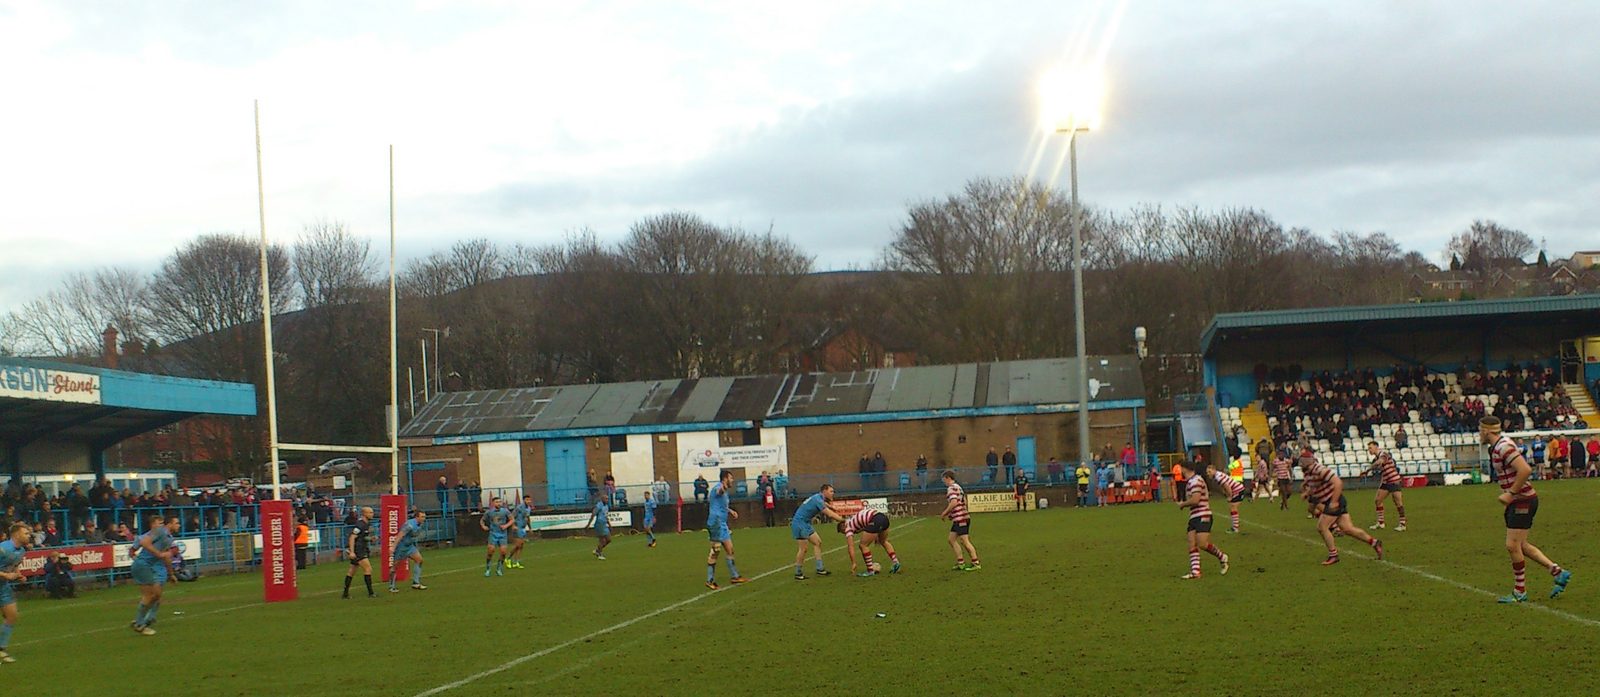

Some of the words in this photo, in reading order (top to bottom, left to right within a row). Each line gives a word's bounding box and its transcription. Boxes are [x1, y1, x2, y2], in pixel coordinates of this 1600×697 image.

[54, 374, 93, 395] Stand
[972, 494, 998, 502] ALKIE
[1000, 493, 1033, 501] LIMD
[271, 518, 283, 546] CIDER
[389, 510, 399, 534] CIDER
[272, 548, 284, 585] PROPER
